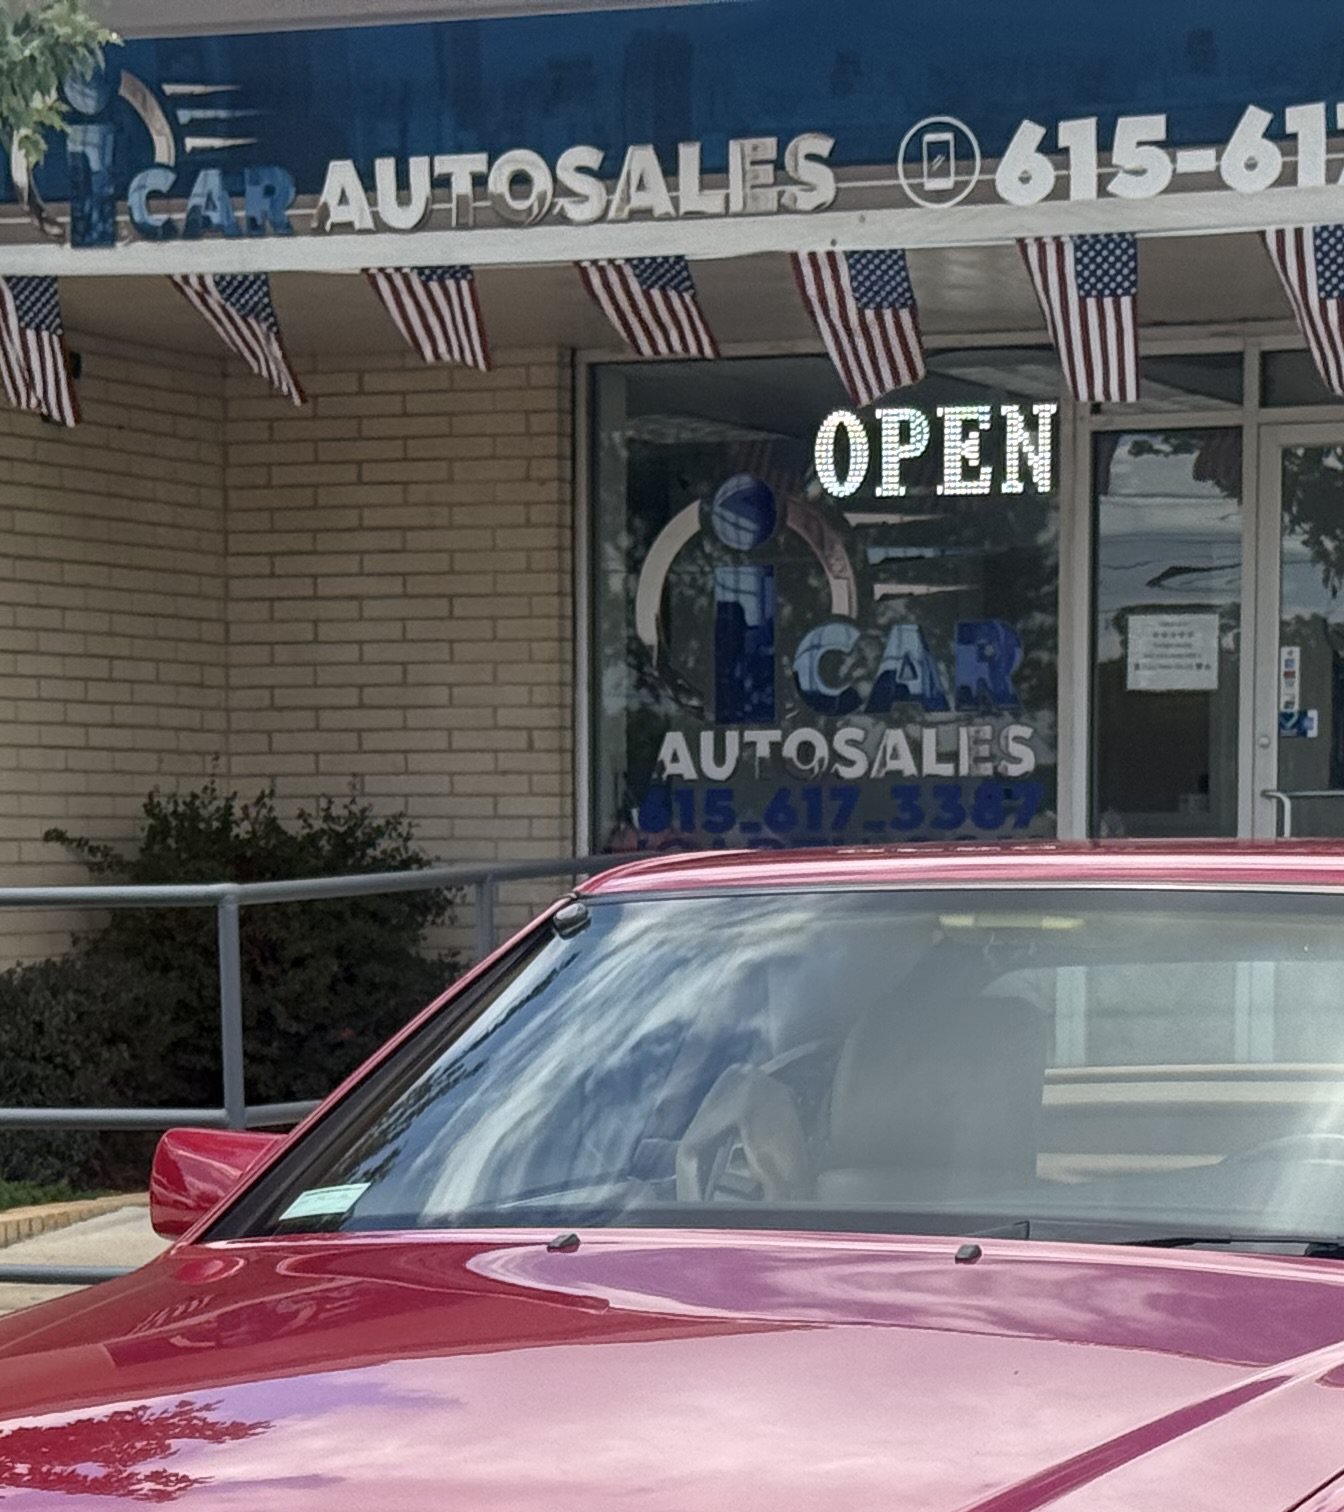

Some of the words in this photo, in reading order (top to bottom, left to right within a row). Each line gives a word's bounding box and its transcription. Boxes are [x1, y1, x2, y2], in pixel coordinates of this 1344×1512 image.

[128, 165, 296, 240] CAR
[310, 132, 838, 234] AUTOSALES
[813, 402, 1058, 498] OPEN
[793, 620, 1025, 715] CAR
[655, 724, 1037, 781] AUTOSALES
